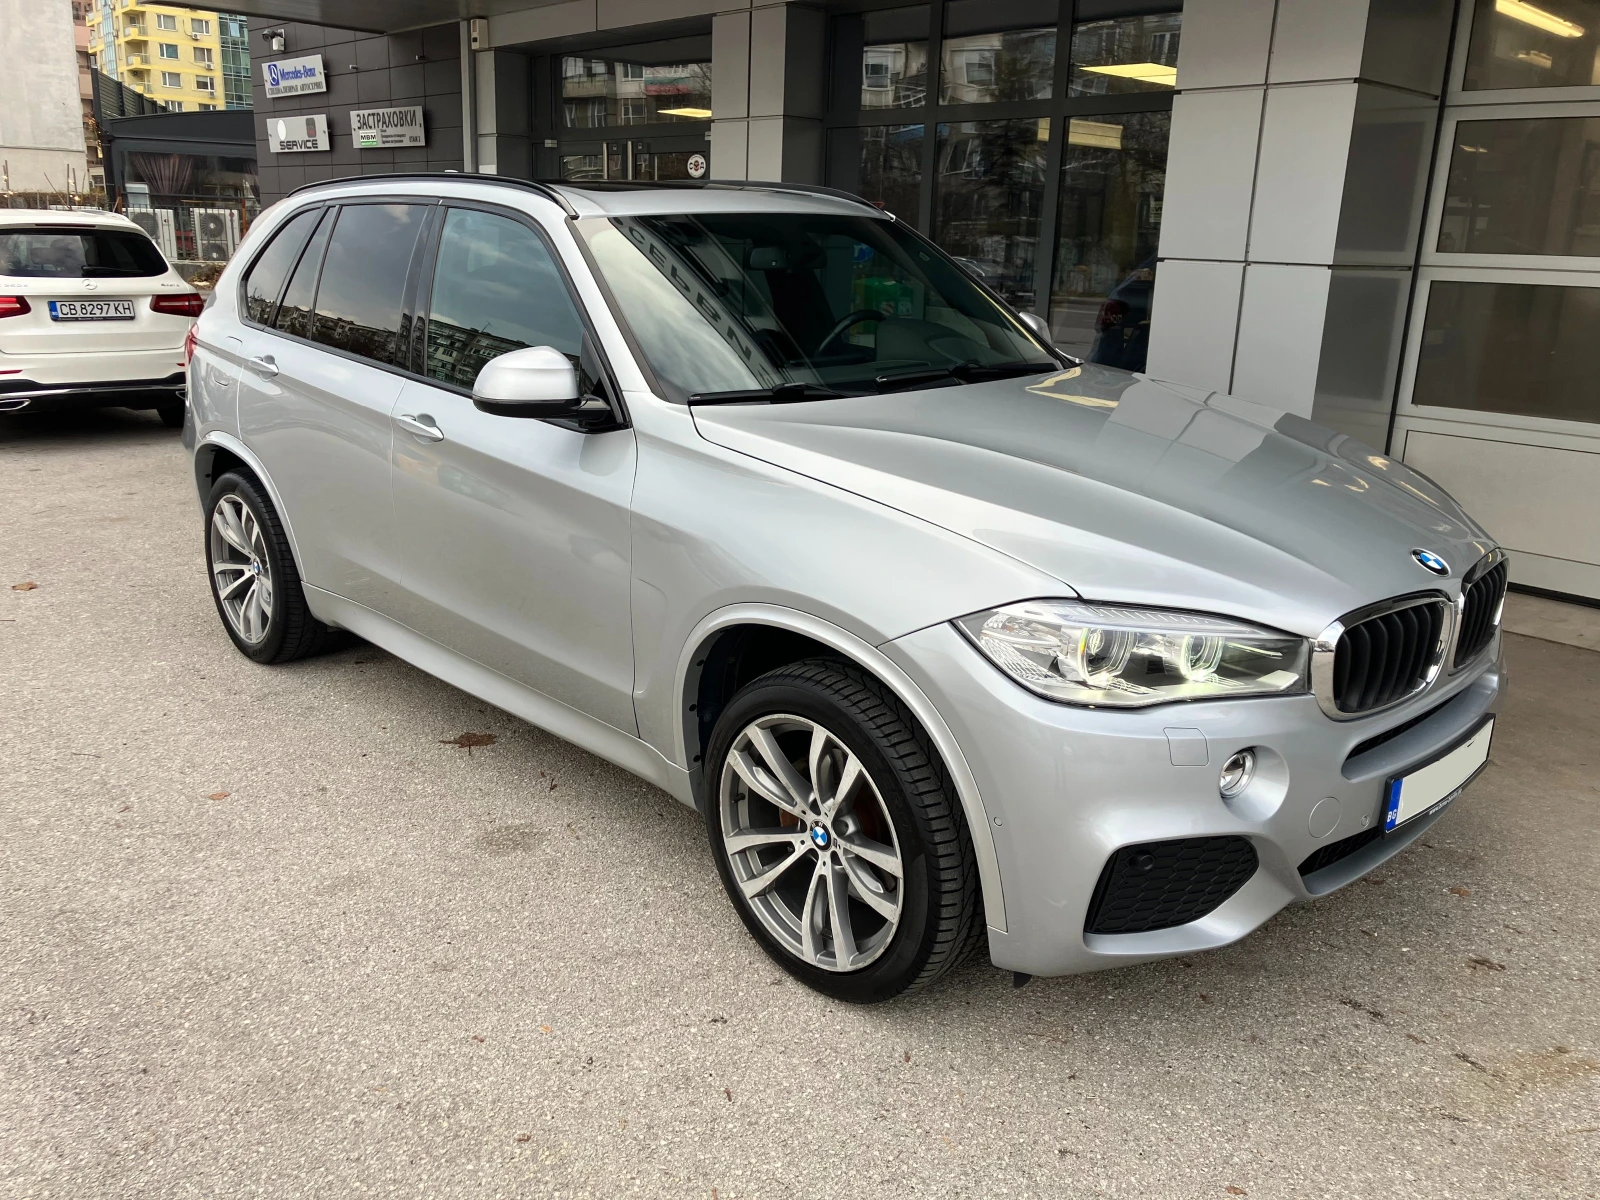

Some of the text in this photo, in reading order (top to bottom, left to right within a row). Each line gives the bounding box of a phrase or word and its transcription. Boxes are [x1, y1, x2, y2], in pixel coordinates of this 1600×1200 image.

[356, 109, 417, 130] ЗАСТРАХОВКИ
[279, 139, 319, 150] SERVICE
[60, 302, 132, 316] CB 8297 KH
[1387, 809, 1397, 822] BG
